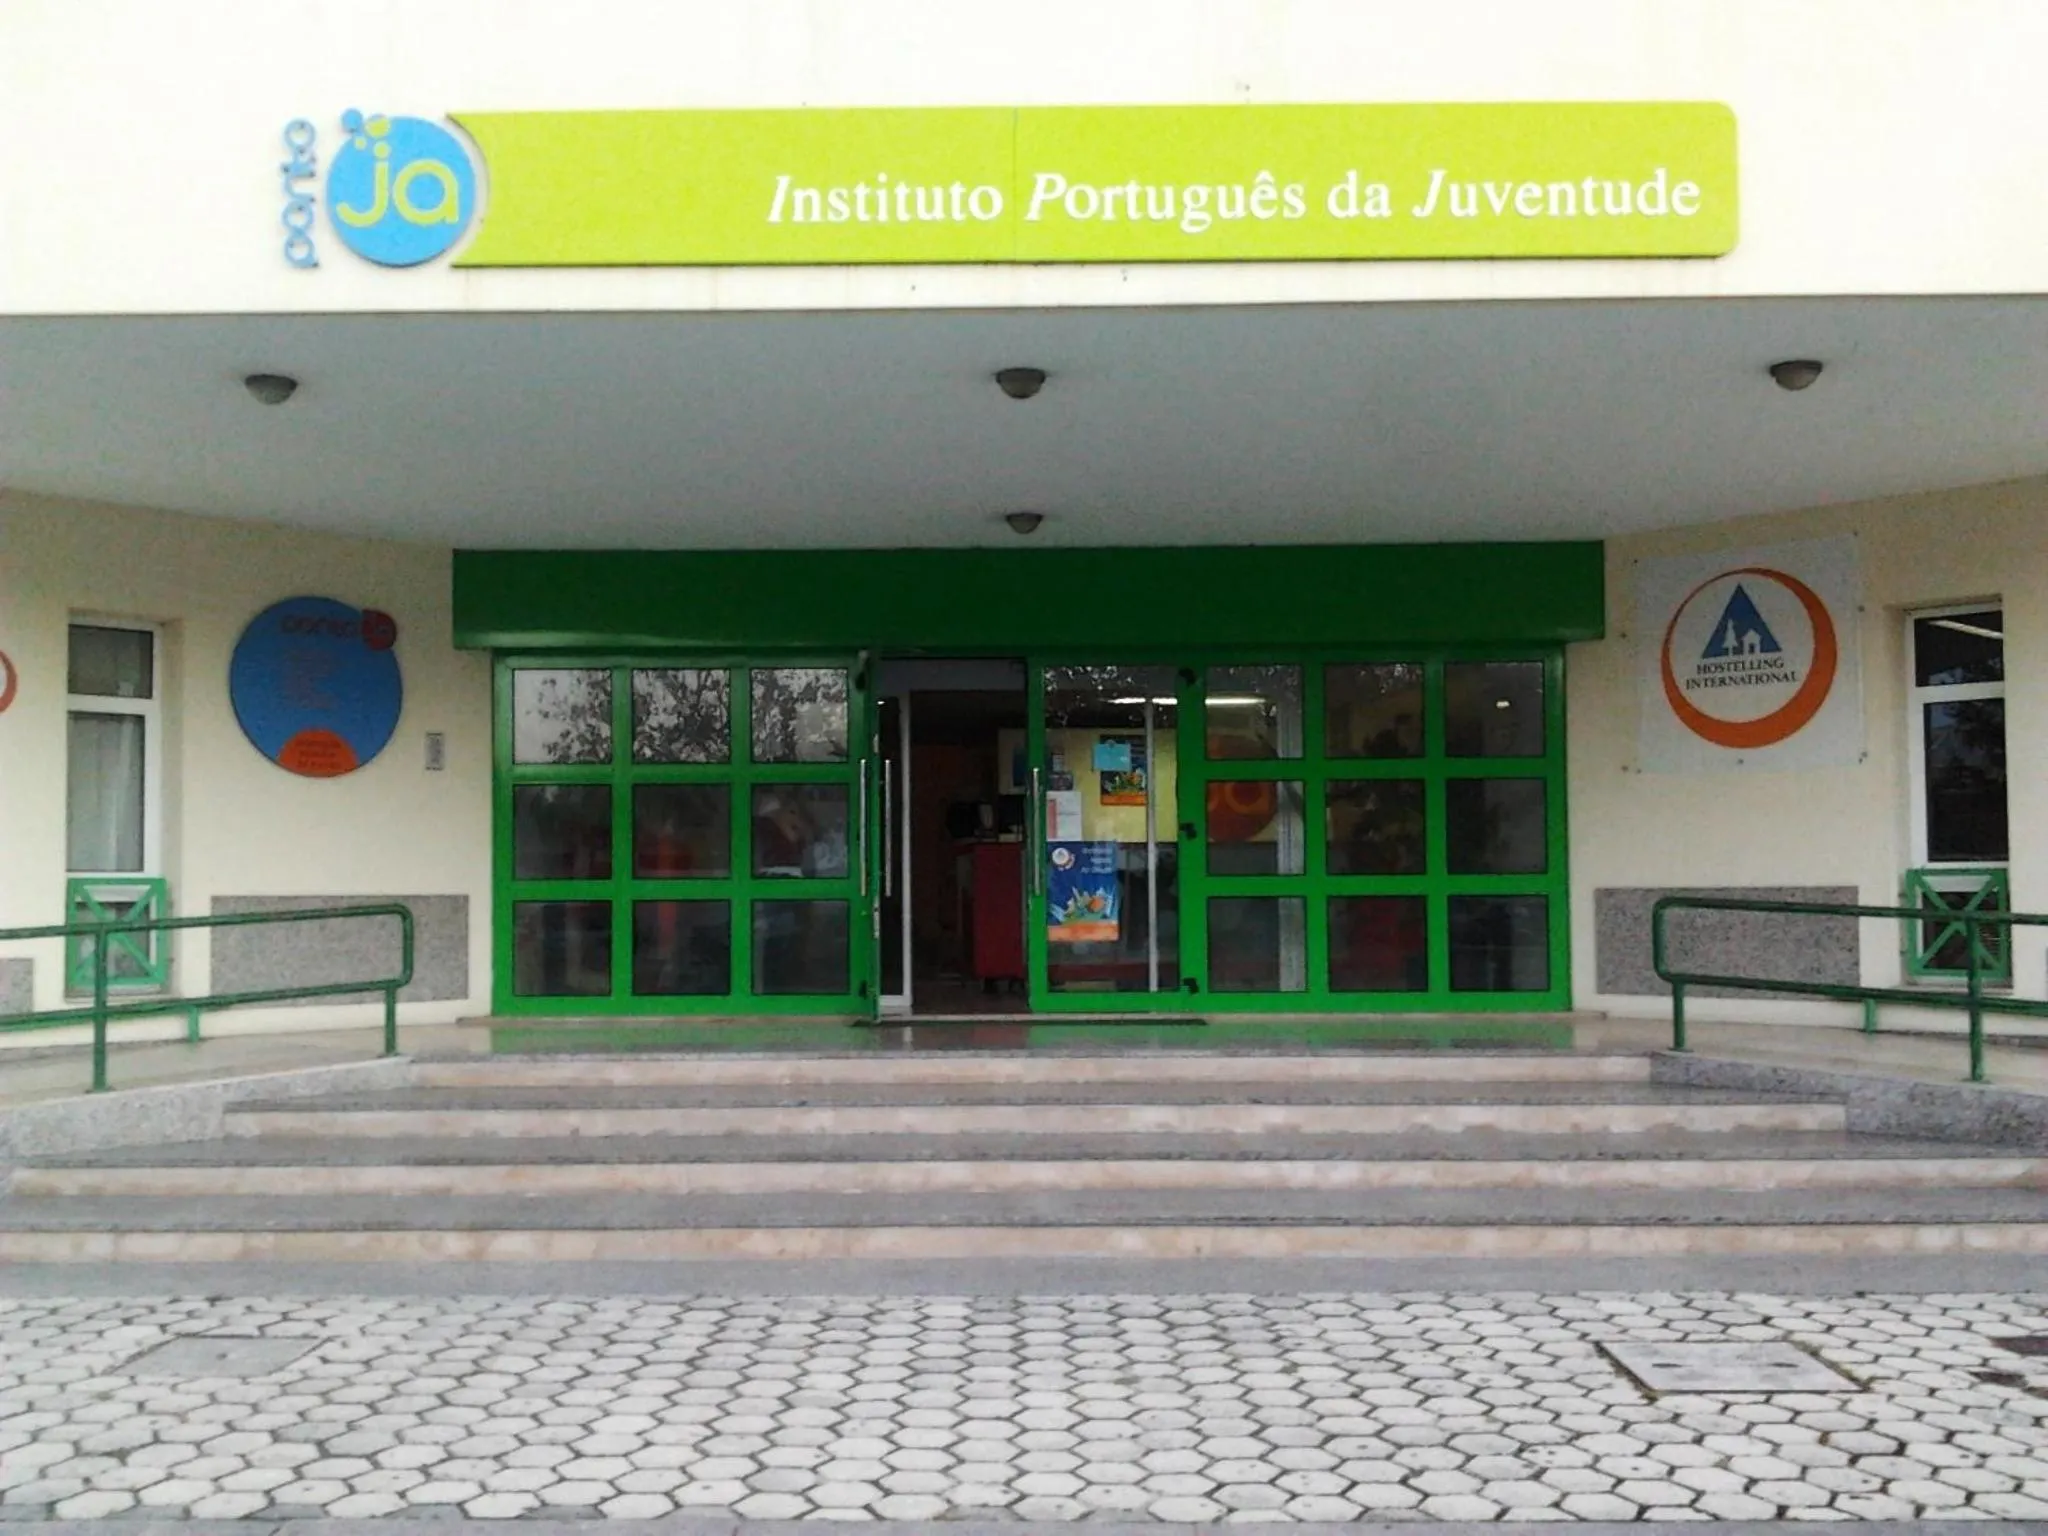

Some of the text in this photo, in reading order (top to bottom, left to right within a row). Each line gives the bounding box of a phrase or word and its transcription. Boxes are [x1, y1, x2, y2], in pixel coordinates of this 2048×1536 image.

[282, 119, 319, 268] ponto
[336, 140, 459, 228] ja
[766, 168, 1701, 233] Instituto Português da Juventude
[1685, 670, 1798, 691] INTERNATIONAL
[1696, 656, 1785, 676] HOSTELLING
